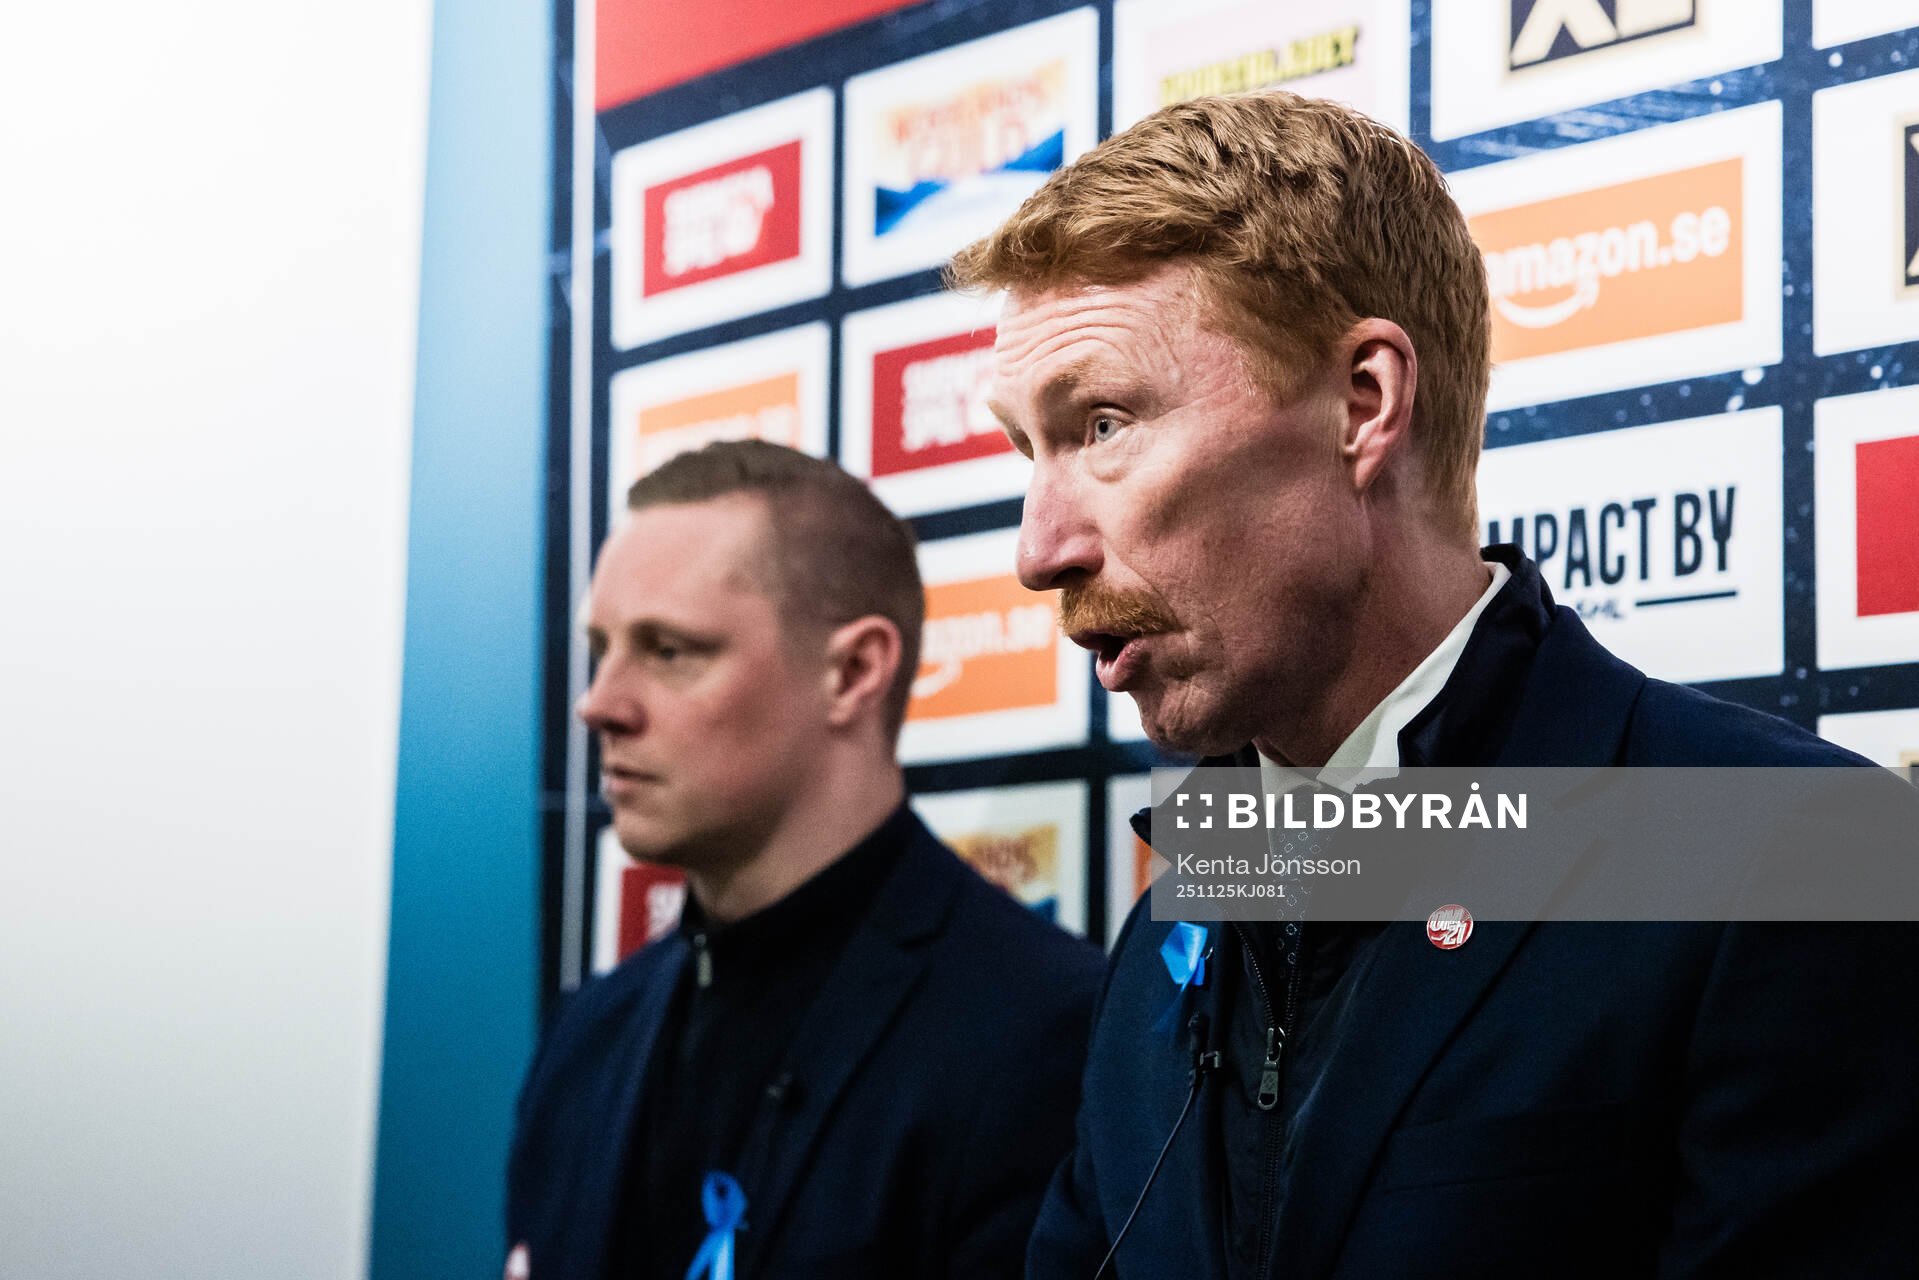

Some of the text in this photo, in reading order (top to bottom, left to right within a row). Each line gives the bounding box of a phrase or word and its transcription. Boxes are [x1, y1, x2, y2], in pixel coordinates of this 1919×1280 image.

[1485, 206, 1731, 298] amazon.se
[1488, 486, 1736, 590] PACT BY
